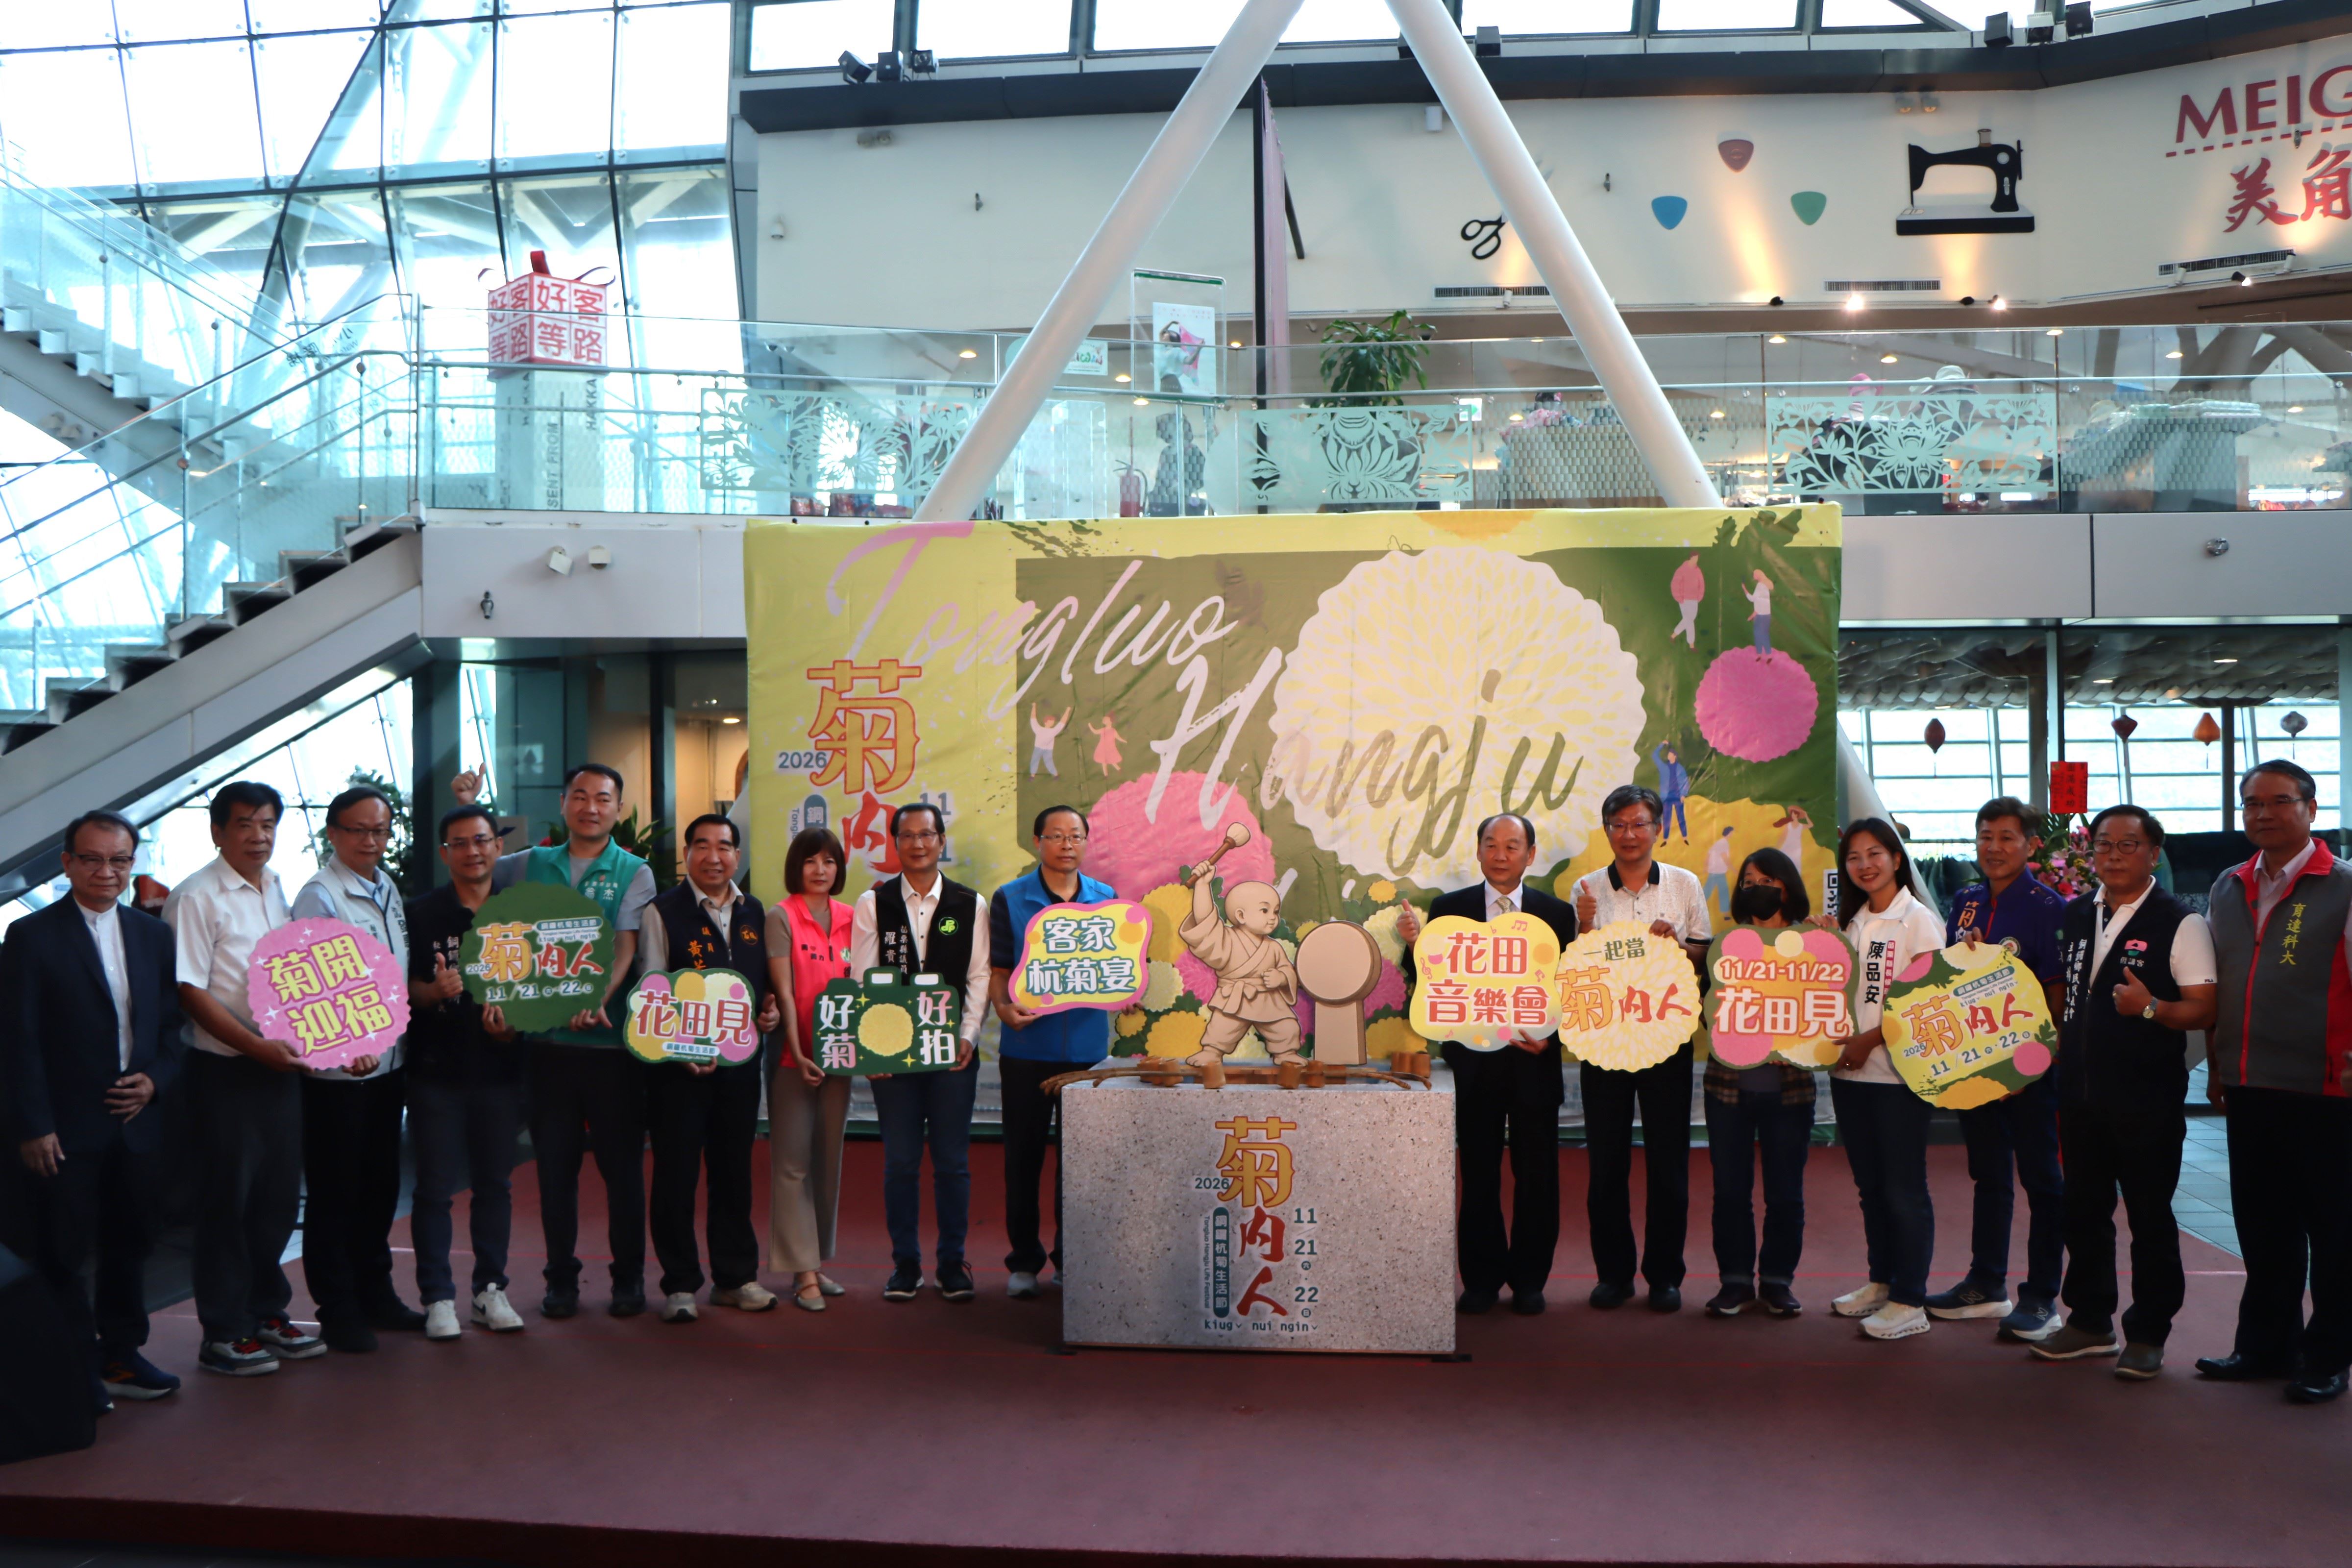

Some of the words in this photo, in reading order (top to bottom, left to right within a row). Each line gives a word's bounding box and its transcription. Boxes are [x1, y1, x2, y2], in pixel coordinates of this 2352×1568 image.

[2223, 149, 2352, 233] 美角
[536, 282, 603, 323] 好客
[538, 322, 602, 364] 等路
[827, 521, 1238, 721] Tongluo
[778, 751, 828, 769] 2026
[1149, 646, 1583, 877] Hangju
[1043, 916, 1117, 953] 客家
[1446, 932, 1528, 975] 花田
[1583, 937, 1646, 962] 一起當
[2279, 903, 2307, 966] 育達科大
[263, 933, 368, 1004] 菊開
[467, 964, 490, 973] 2026
[562, 981, 581, 993] 22
[1026, 956, 1137, 995] 杭菊宴
[1720, 958, 1845, 982] 11/21-11/22
[1864, 940, 1886, 1004] 陳品安
[286, 982, 393, 1056] 迎福
[636, 990, 751, 1045] 花田見
[1426, 979, 1549, 1025] 音樂會
[1714, 985, 1850, 1038] 花田見
[1903, 1042, 1926, 1057] 2026
[1999, 1031, 2020, 1049] 22
[1195, 1177, 1230, 1191] 2026
[1252, 1321, 1273, 1331] nui
